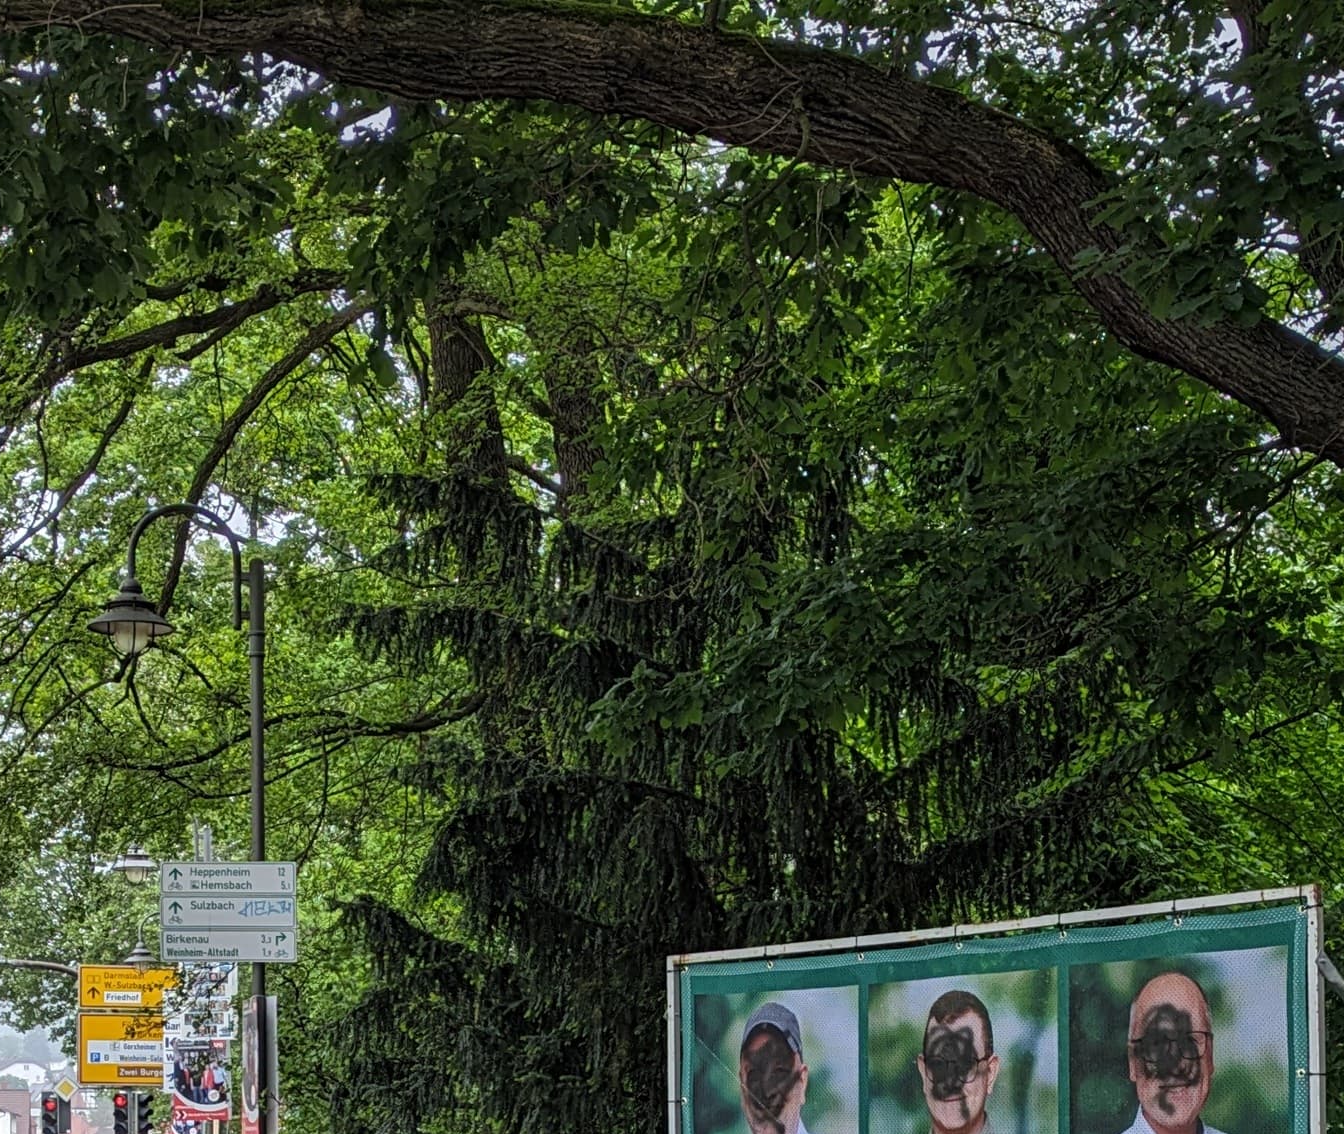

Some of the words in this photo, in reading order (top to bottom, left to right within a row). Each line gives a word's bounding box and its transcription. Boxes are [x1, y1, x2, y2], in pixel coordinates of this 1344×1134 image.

[190, 867, 251, 878] Heppenheim
[277, 867, 286, 877] 12
[200, 880, 253, 890] Hemsbach
[190, 901, 235, 910] Sulzbach
[166, 934, 209, 944] Birkenau
[166, 947, 239, 957] Weinheim-Altstadt
[106, 993, 139, 1001] Friedhof
[119, 1068, 138, 1077] Zwei
